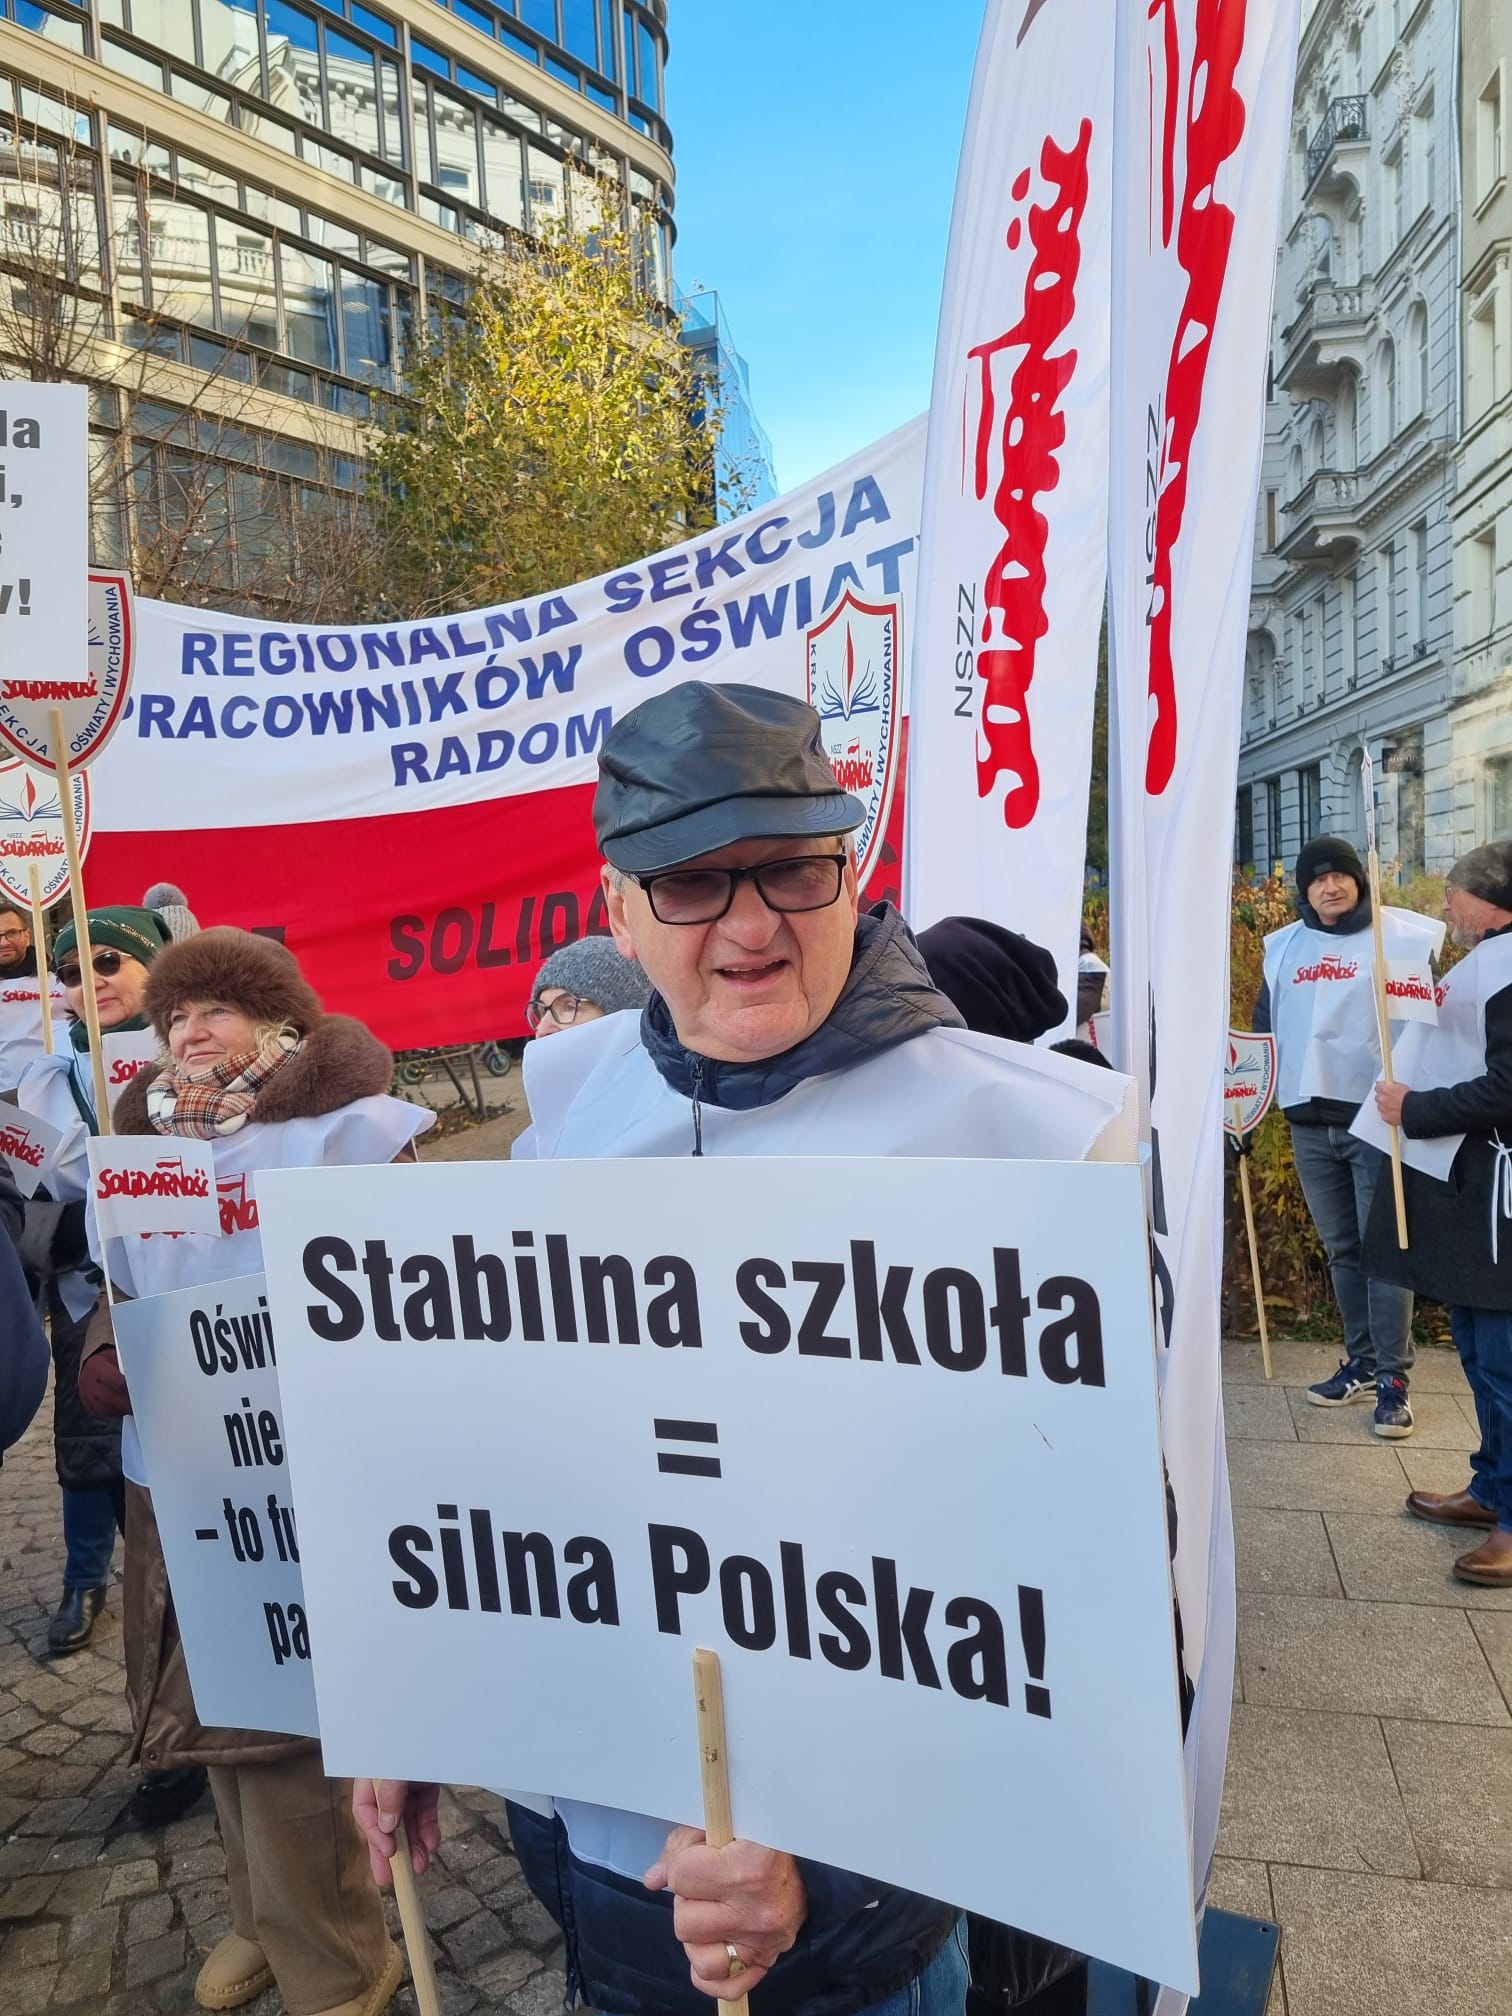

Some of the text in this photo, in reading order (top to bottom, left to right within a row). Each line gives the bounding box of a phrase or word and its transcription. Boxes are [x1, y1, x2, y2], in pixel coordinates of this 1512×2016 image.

[182, 475, 890, 677] REGIONALNA SEKCJA
[624, 534, 921, 678] OŚWIAT
[70, 697, 110, 753] OŚWIATY
[104, 586, 121, 688] WYCHOWANIA
[876, 619, 892, 774] WYCHOWANIA
[954, 582, 976, 718] NSZZ
[390, 706, 614, 787] RADOM
[189, 1295, 277, 1377] Oświ
[302, 1230, 1107, 1388] Stabilna szkoła
[223, 1396, 284, 1468] nie
[653, 1418, 722, 1479] =
[222, 1497, 265, 1563] to
[262, 1601, 312, 1666] pa
[388, 1503, 621, 1627] silna
[647, 1522, 1052, 1720] Polska!
